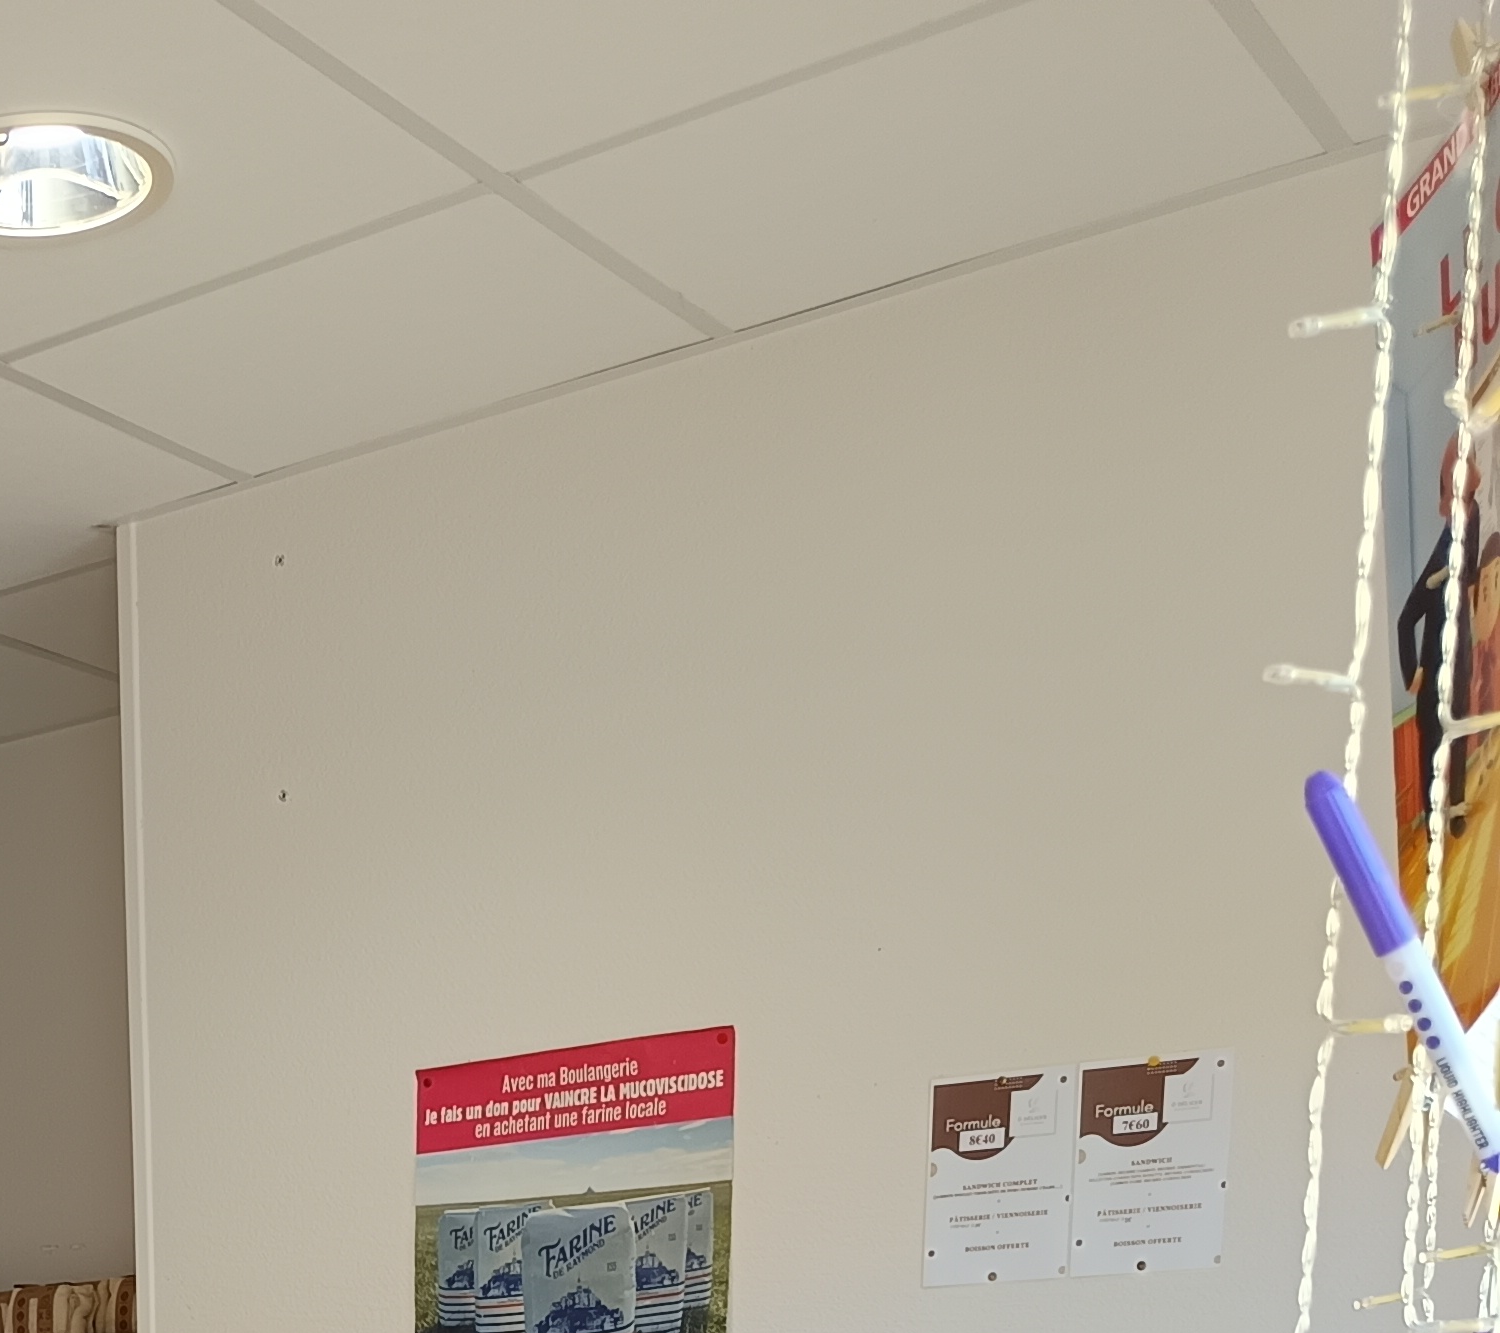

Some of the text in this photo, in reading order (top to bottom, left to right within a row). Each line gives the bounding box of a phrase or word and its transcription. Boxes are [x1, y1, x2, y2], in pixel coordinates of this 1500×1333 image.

[502, 1057, 639, 1094] Avec ma Boulangerie
[1436, 1057, 1458, 1088] LIQUID
[424, 1069, 724, 1126] Je fais un don pour VAINCRE LA MUCOVISCIDOSE
[1095, 1099, 1154, 1119] Formule
[475, 1098, 667, 1139] en achetant une farine locale
[945, 1114, 1001, 1132] Formule
[1122, 1119, 1150, 1131] 7€60
[1453, 1089, 1489, 1150] HIGHLIGHTER
[968, 1133, 996, 1146] 8€40
[537, 1213, 618, 1279] FARINE
